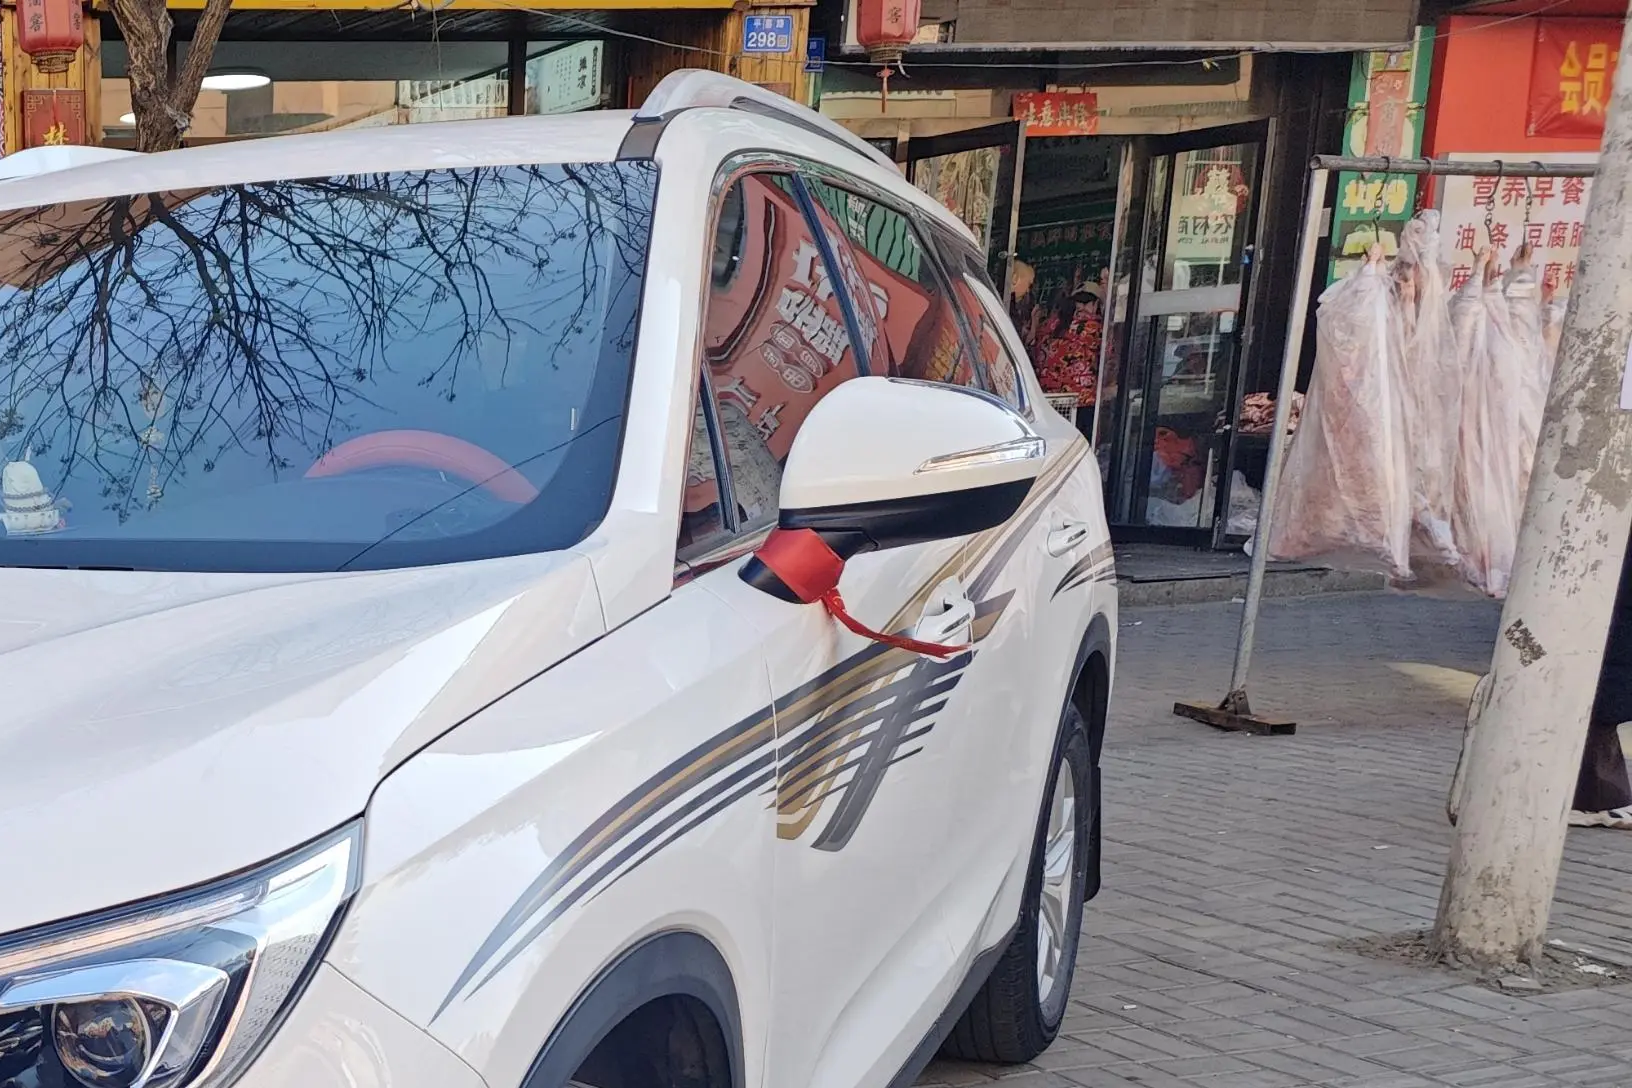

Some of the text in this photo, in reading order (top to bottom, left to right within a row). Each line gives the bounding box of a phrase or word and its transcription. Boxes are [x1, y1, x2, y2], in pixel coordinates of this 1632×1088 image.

[747, 32, 776, 48] 298
[1558, 40, 1617, 117] 会员
[1472, 176, 1585, 206] 营养早餐
[1455, 222, 1509, 251] 油条
